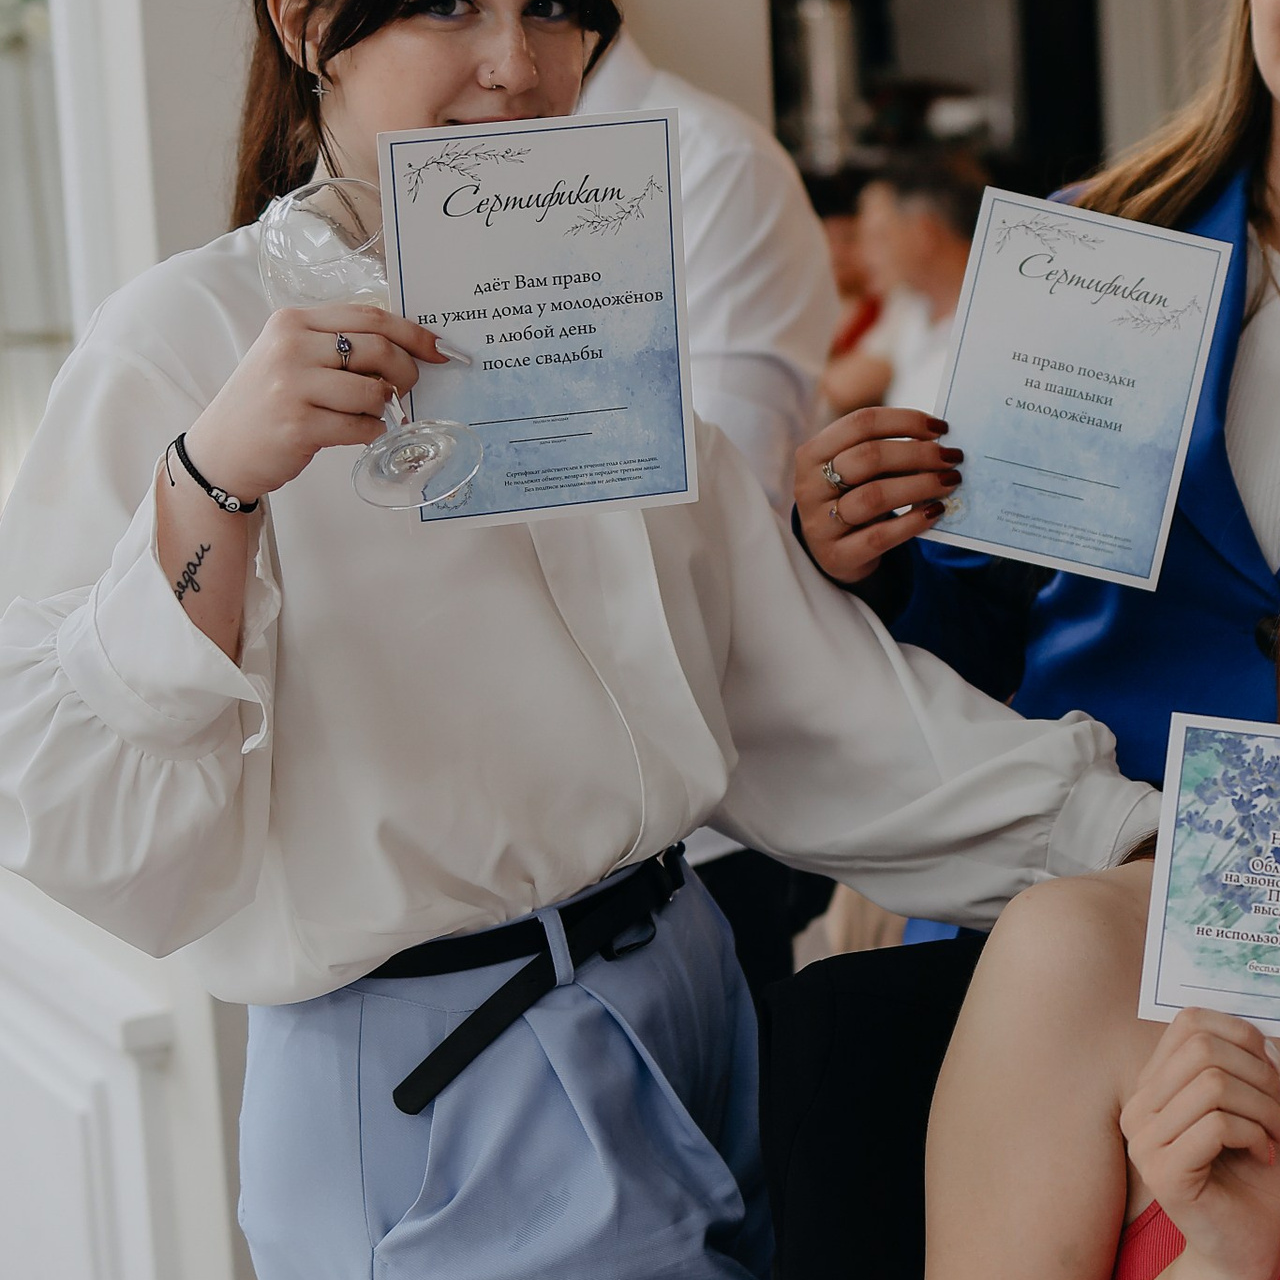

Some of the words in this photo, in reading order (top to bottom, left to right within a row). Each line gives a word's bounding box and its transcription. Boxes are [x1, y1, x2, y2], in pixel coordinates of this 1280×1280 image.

[442, 174, 625, 227] Сертификат
[473, 277, 510, 296] даёт
[514, 274, 548, 290] Вам
[551, 271, 602, 290] право
[1018, 253, 1168, 308] Сертификат
[416, 313, 438, 327] на
[440, 308, 488, 328] ужин
[491, 303, 534, 320] дома
[536, 302, 547, 318] у
[550, 289, 664, 312] молодожёнов
[484, 333, 495, 345] в
[498, 324, 555, 343] любой
[558, 323, 597, 339] день
[482, 355, 531, 371] после
[534, 344, 604, 365] свадьбы
[1011, 351, 1029, 364] на
[1031, 355, 1075, 373] право
[1076, 366, 1136, 388] поездки
[1023, 377, 1041, 390] на
[1043, 382, 1114, 407] шашлыки
[1004, 396, 1014, 407] с
[1015, 399, 1123, 433] молодожёнами
[1224, 872, 1240, 883] на
[1195, 926, 1213, 937] не
